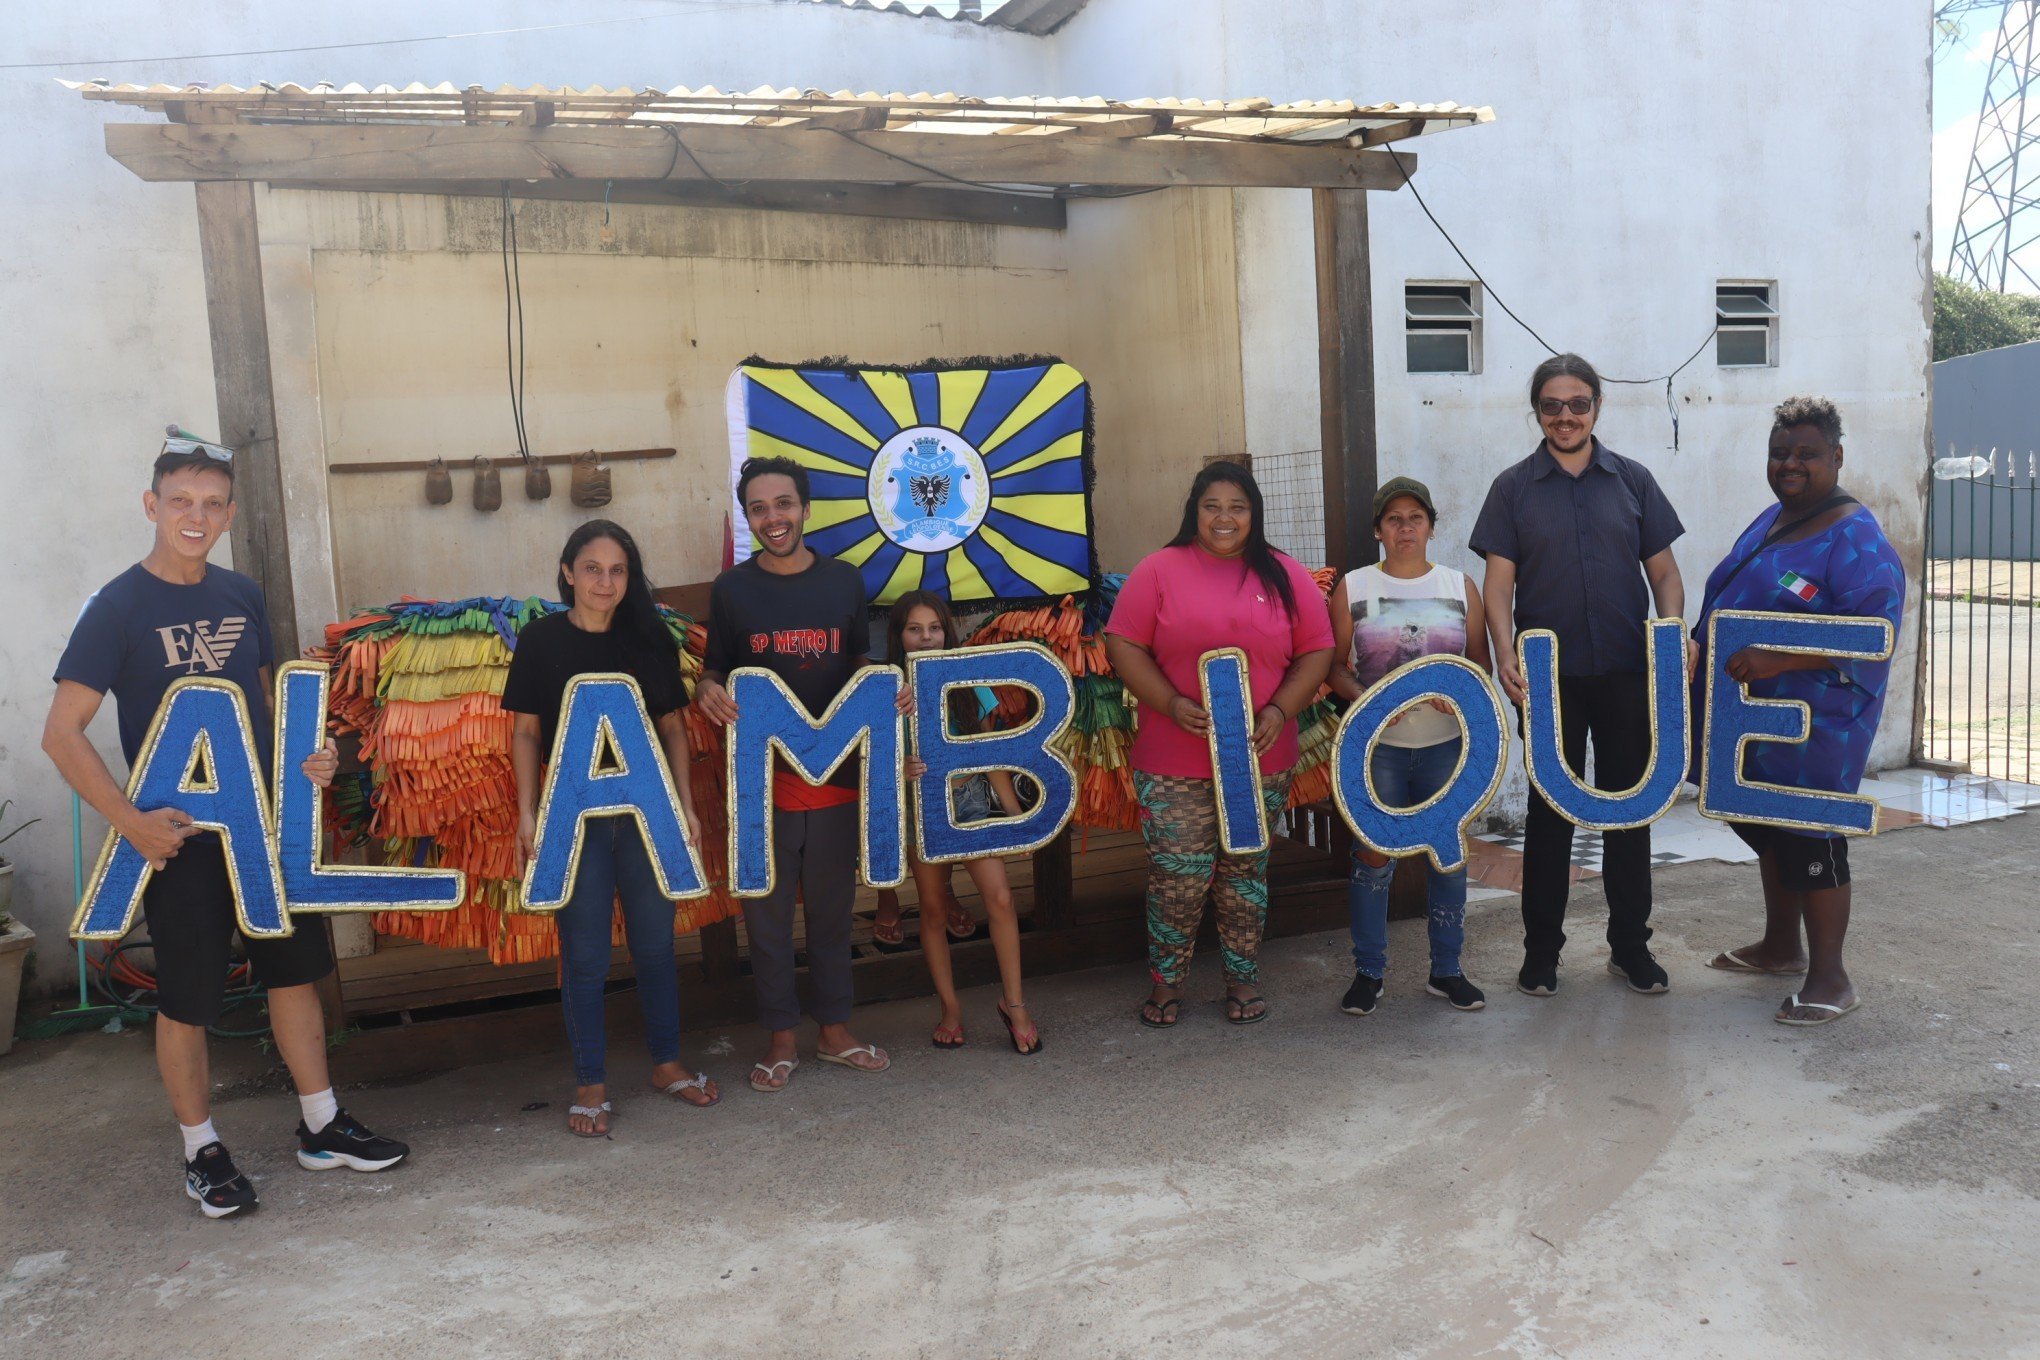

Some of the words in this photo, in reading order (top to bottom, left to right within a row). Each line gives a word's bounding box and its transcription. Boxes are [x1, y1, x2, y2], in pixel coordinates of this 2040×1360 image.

[750, 632, 769, 653] SP
[773, 628, 827, 659] METRO
[68, 608, 1894, 941] ALAMBIQUE
